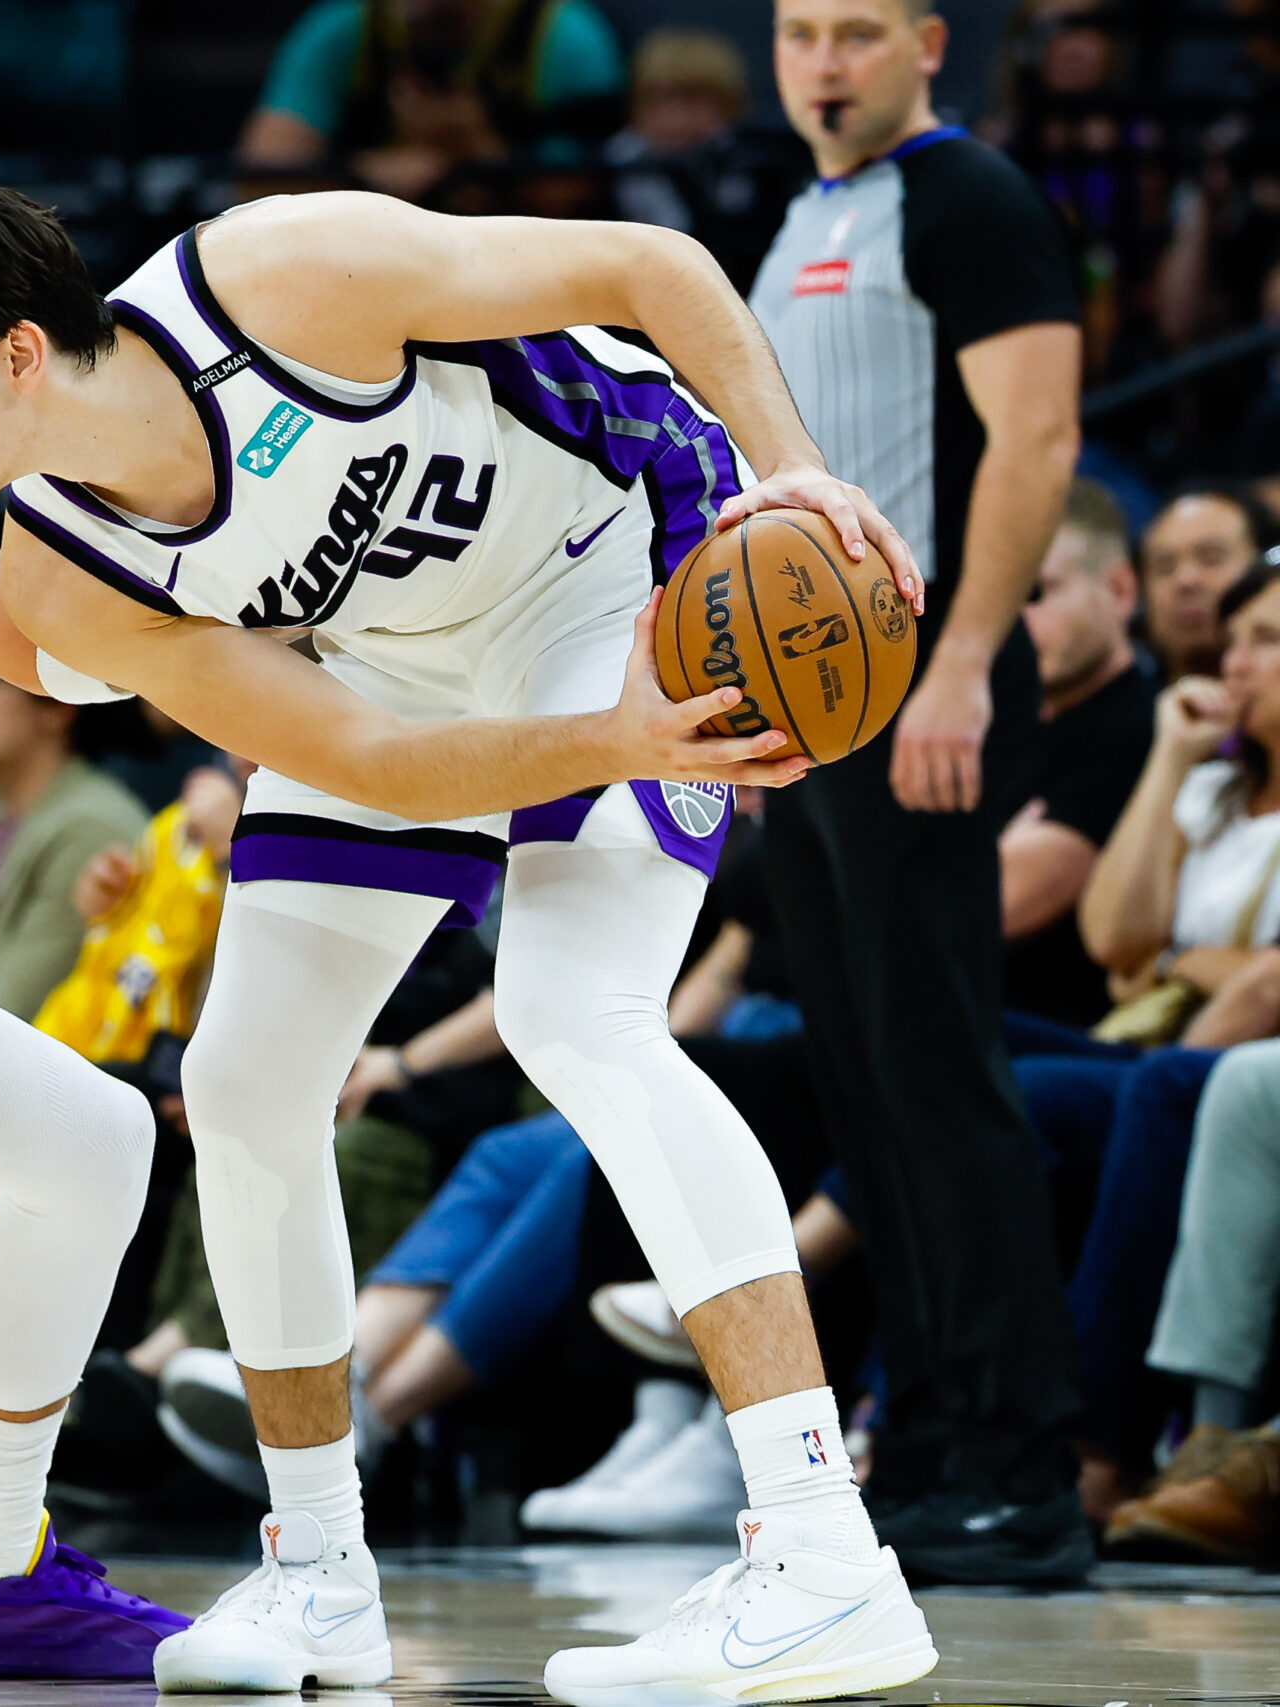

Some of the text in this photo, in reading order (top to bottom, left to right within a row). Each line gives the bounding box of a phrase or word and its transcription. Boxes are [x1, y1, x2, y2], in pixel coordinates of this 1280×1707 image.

[192, 351, 252, 393] ADELMAN
[261, 407, 293, 443] Sutter
[273, 414, 308, 449] Health
[237, 443, 409, 628] Kings
[359, 454, 497, 580] 42
